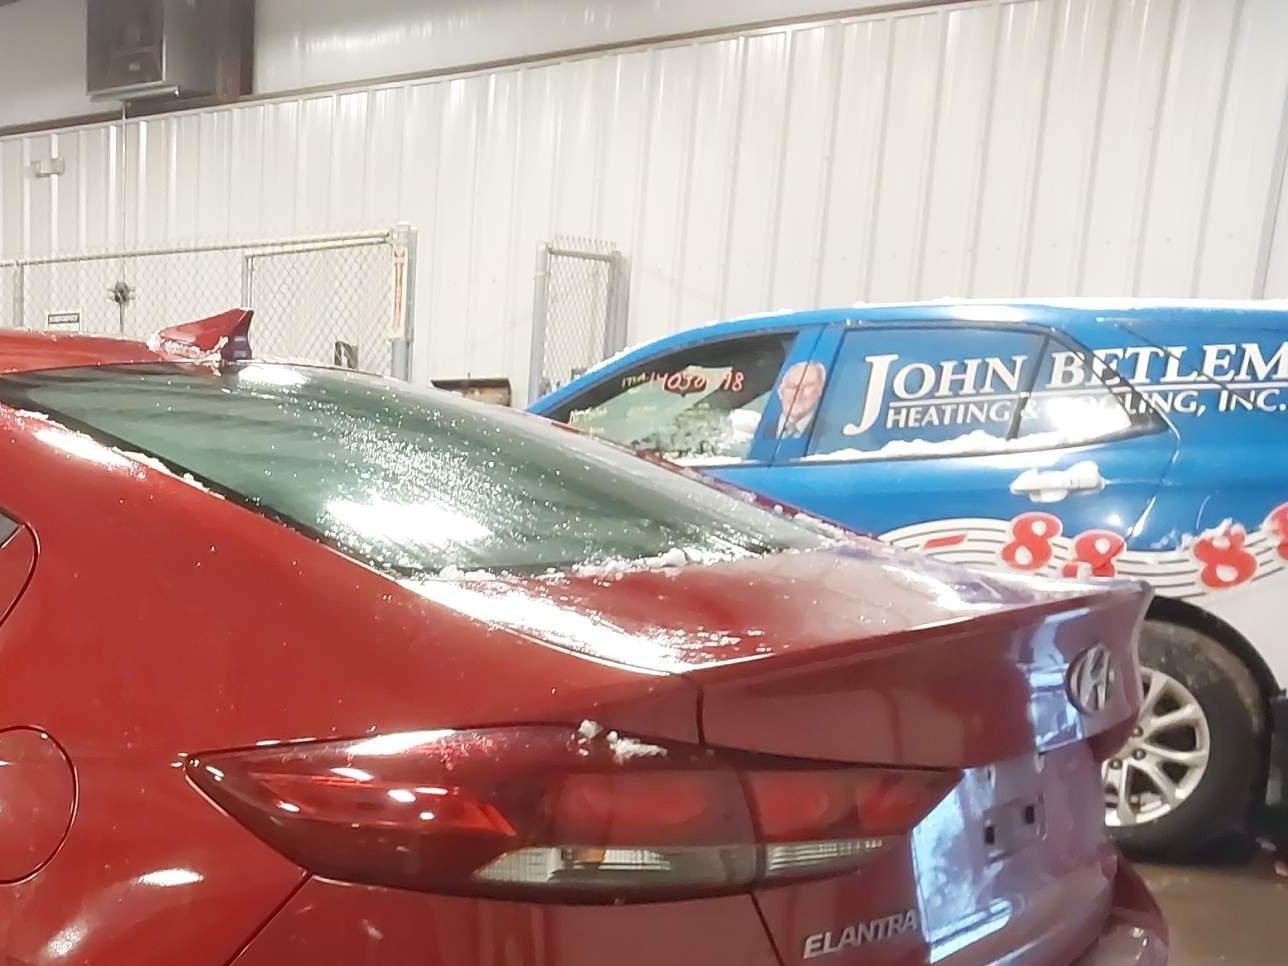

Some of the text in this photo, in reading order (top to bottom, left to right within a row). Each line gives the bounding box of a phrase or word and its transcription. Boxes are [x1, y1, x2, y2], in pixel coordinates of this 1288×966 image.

[842, 353, 1029, 436] JOHN
[885, 401, 1011, 429] HEATING
[1218, 389, 1286, 413] INC.
[803, 907, 918, 959] ELANTRA
